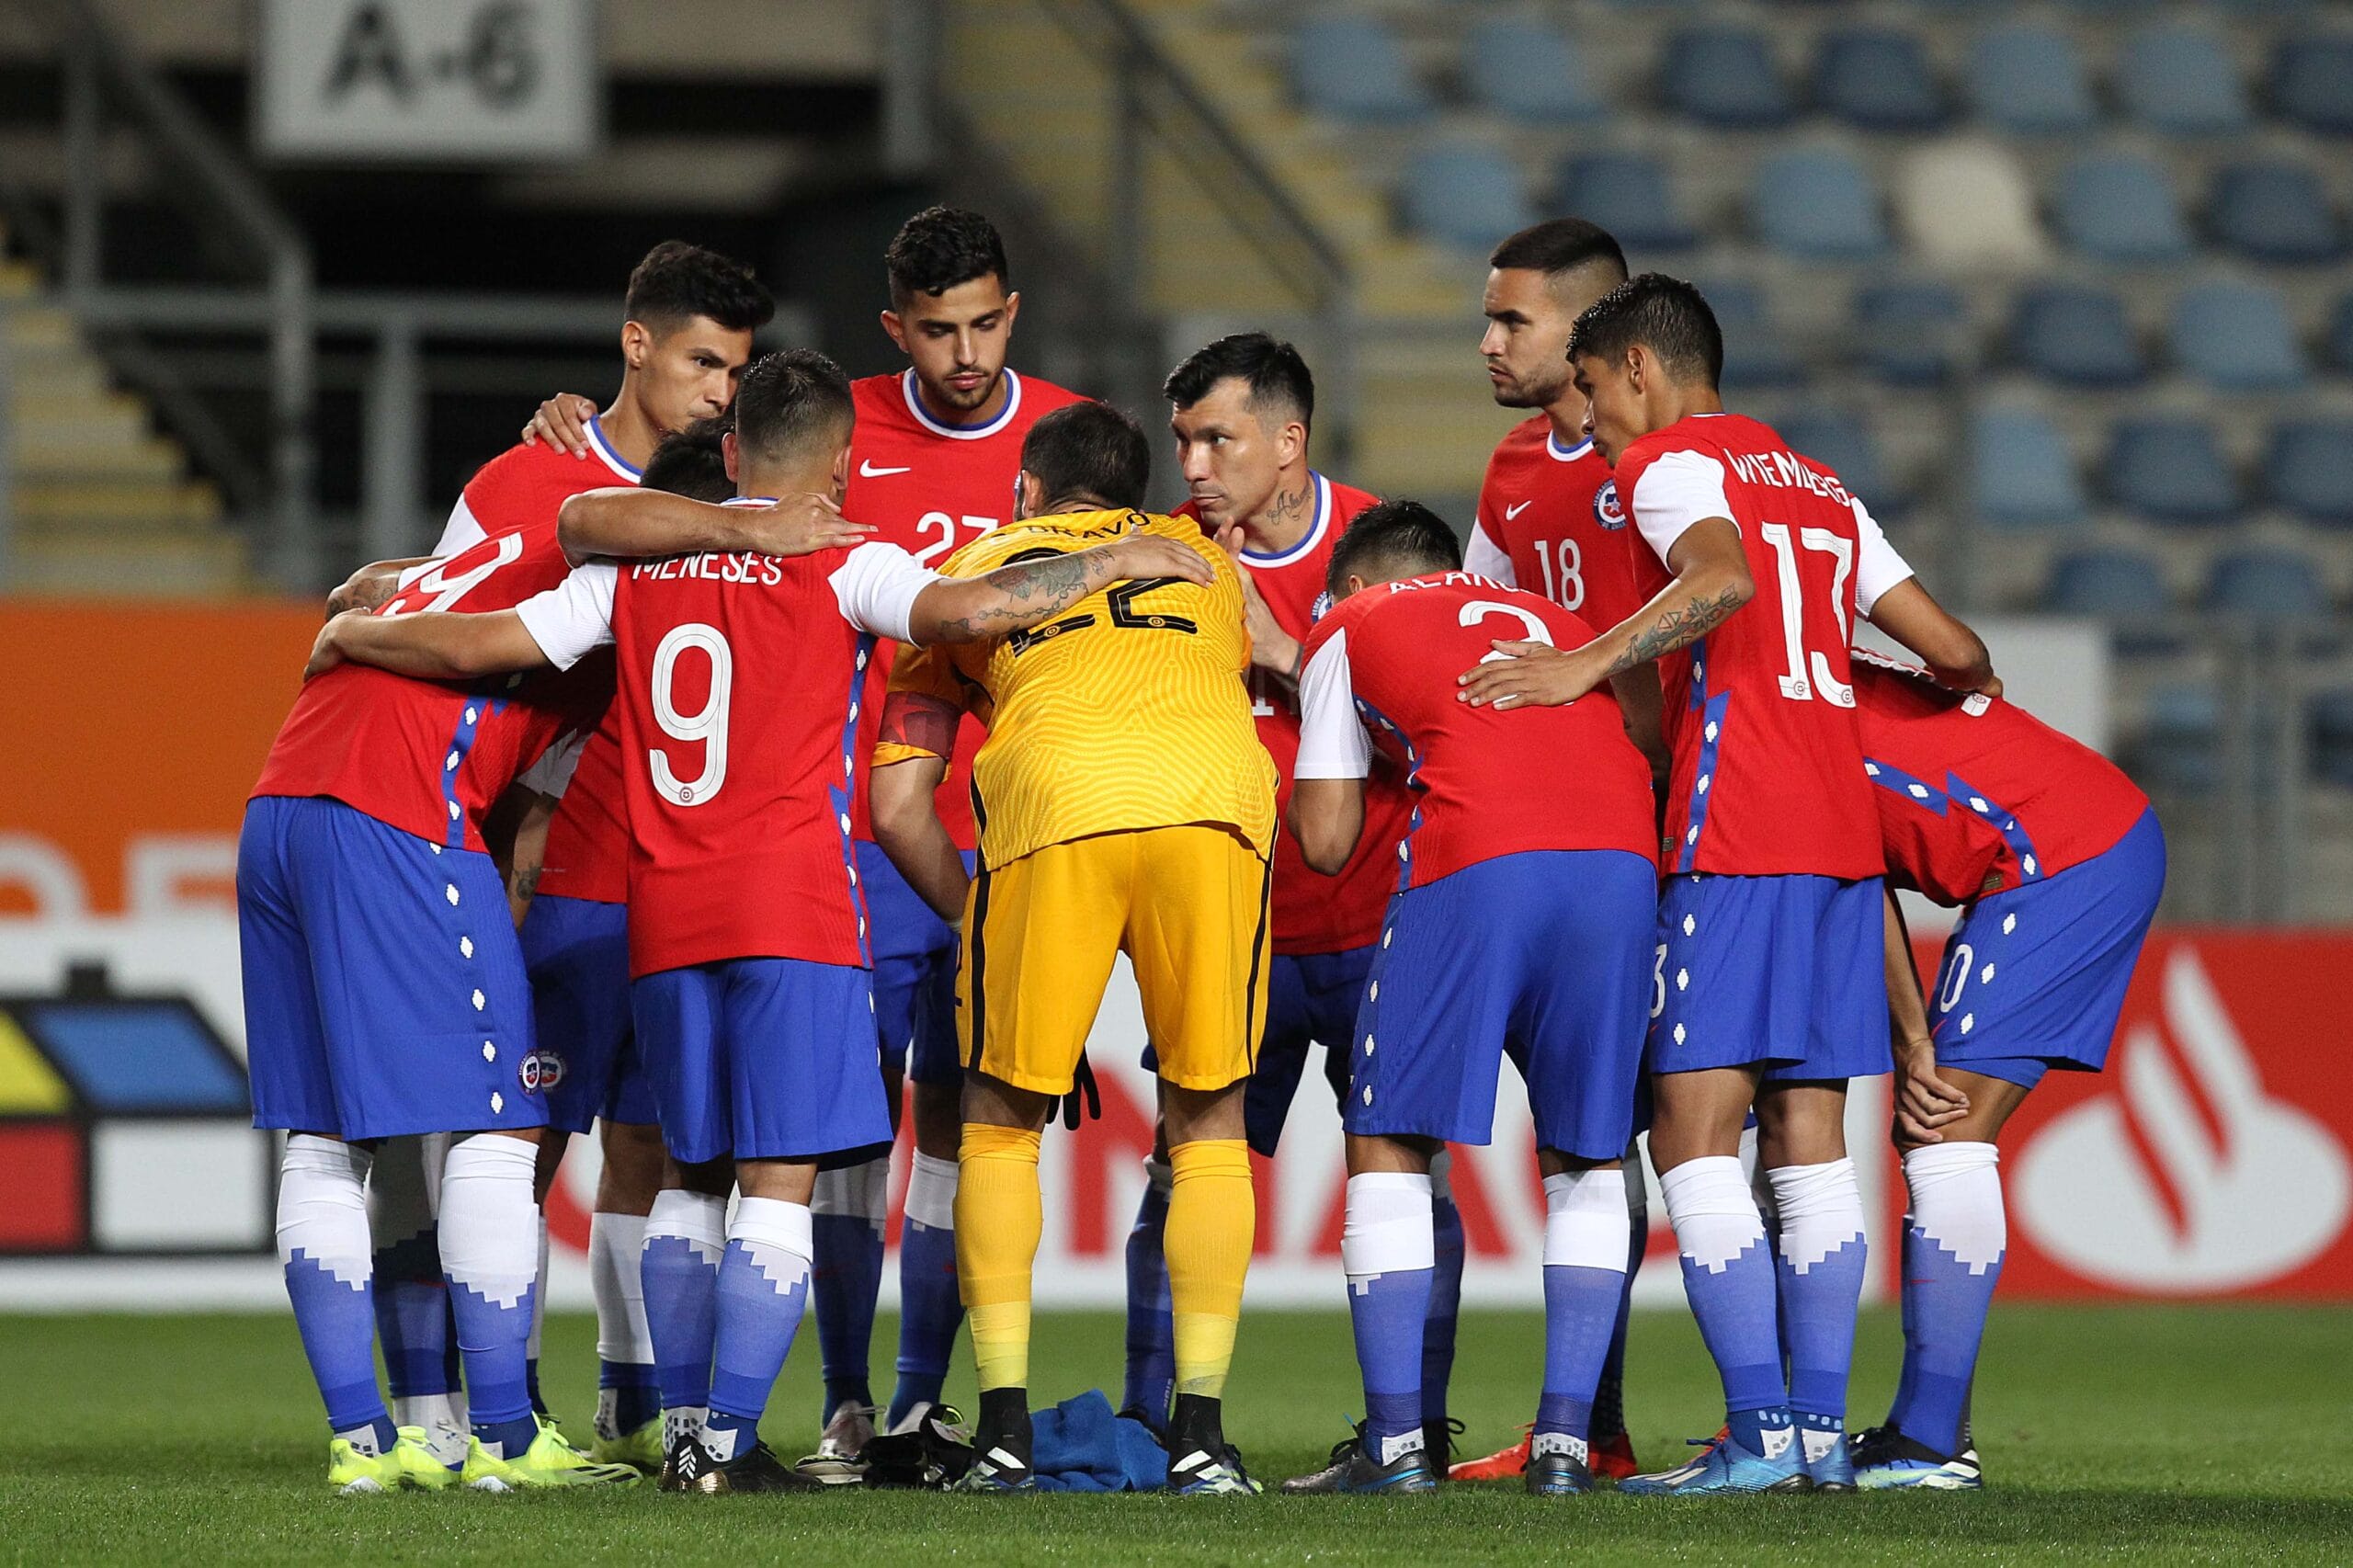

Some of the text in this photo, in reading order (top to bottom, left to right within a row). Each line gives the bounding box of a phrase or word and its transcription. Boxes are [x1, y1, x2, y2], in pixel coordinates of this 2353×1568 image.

[1027, 512, 1151, 539] BRAVO
[632, 551, 782, 585] MENESES
[1534, 538, 1585, 611] 18
[649, 622, 733, 807] 9
